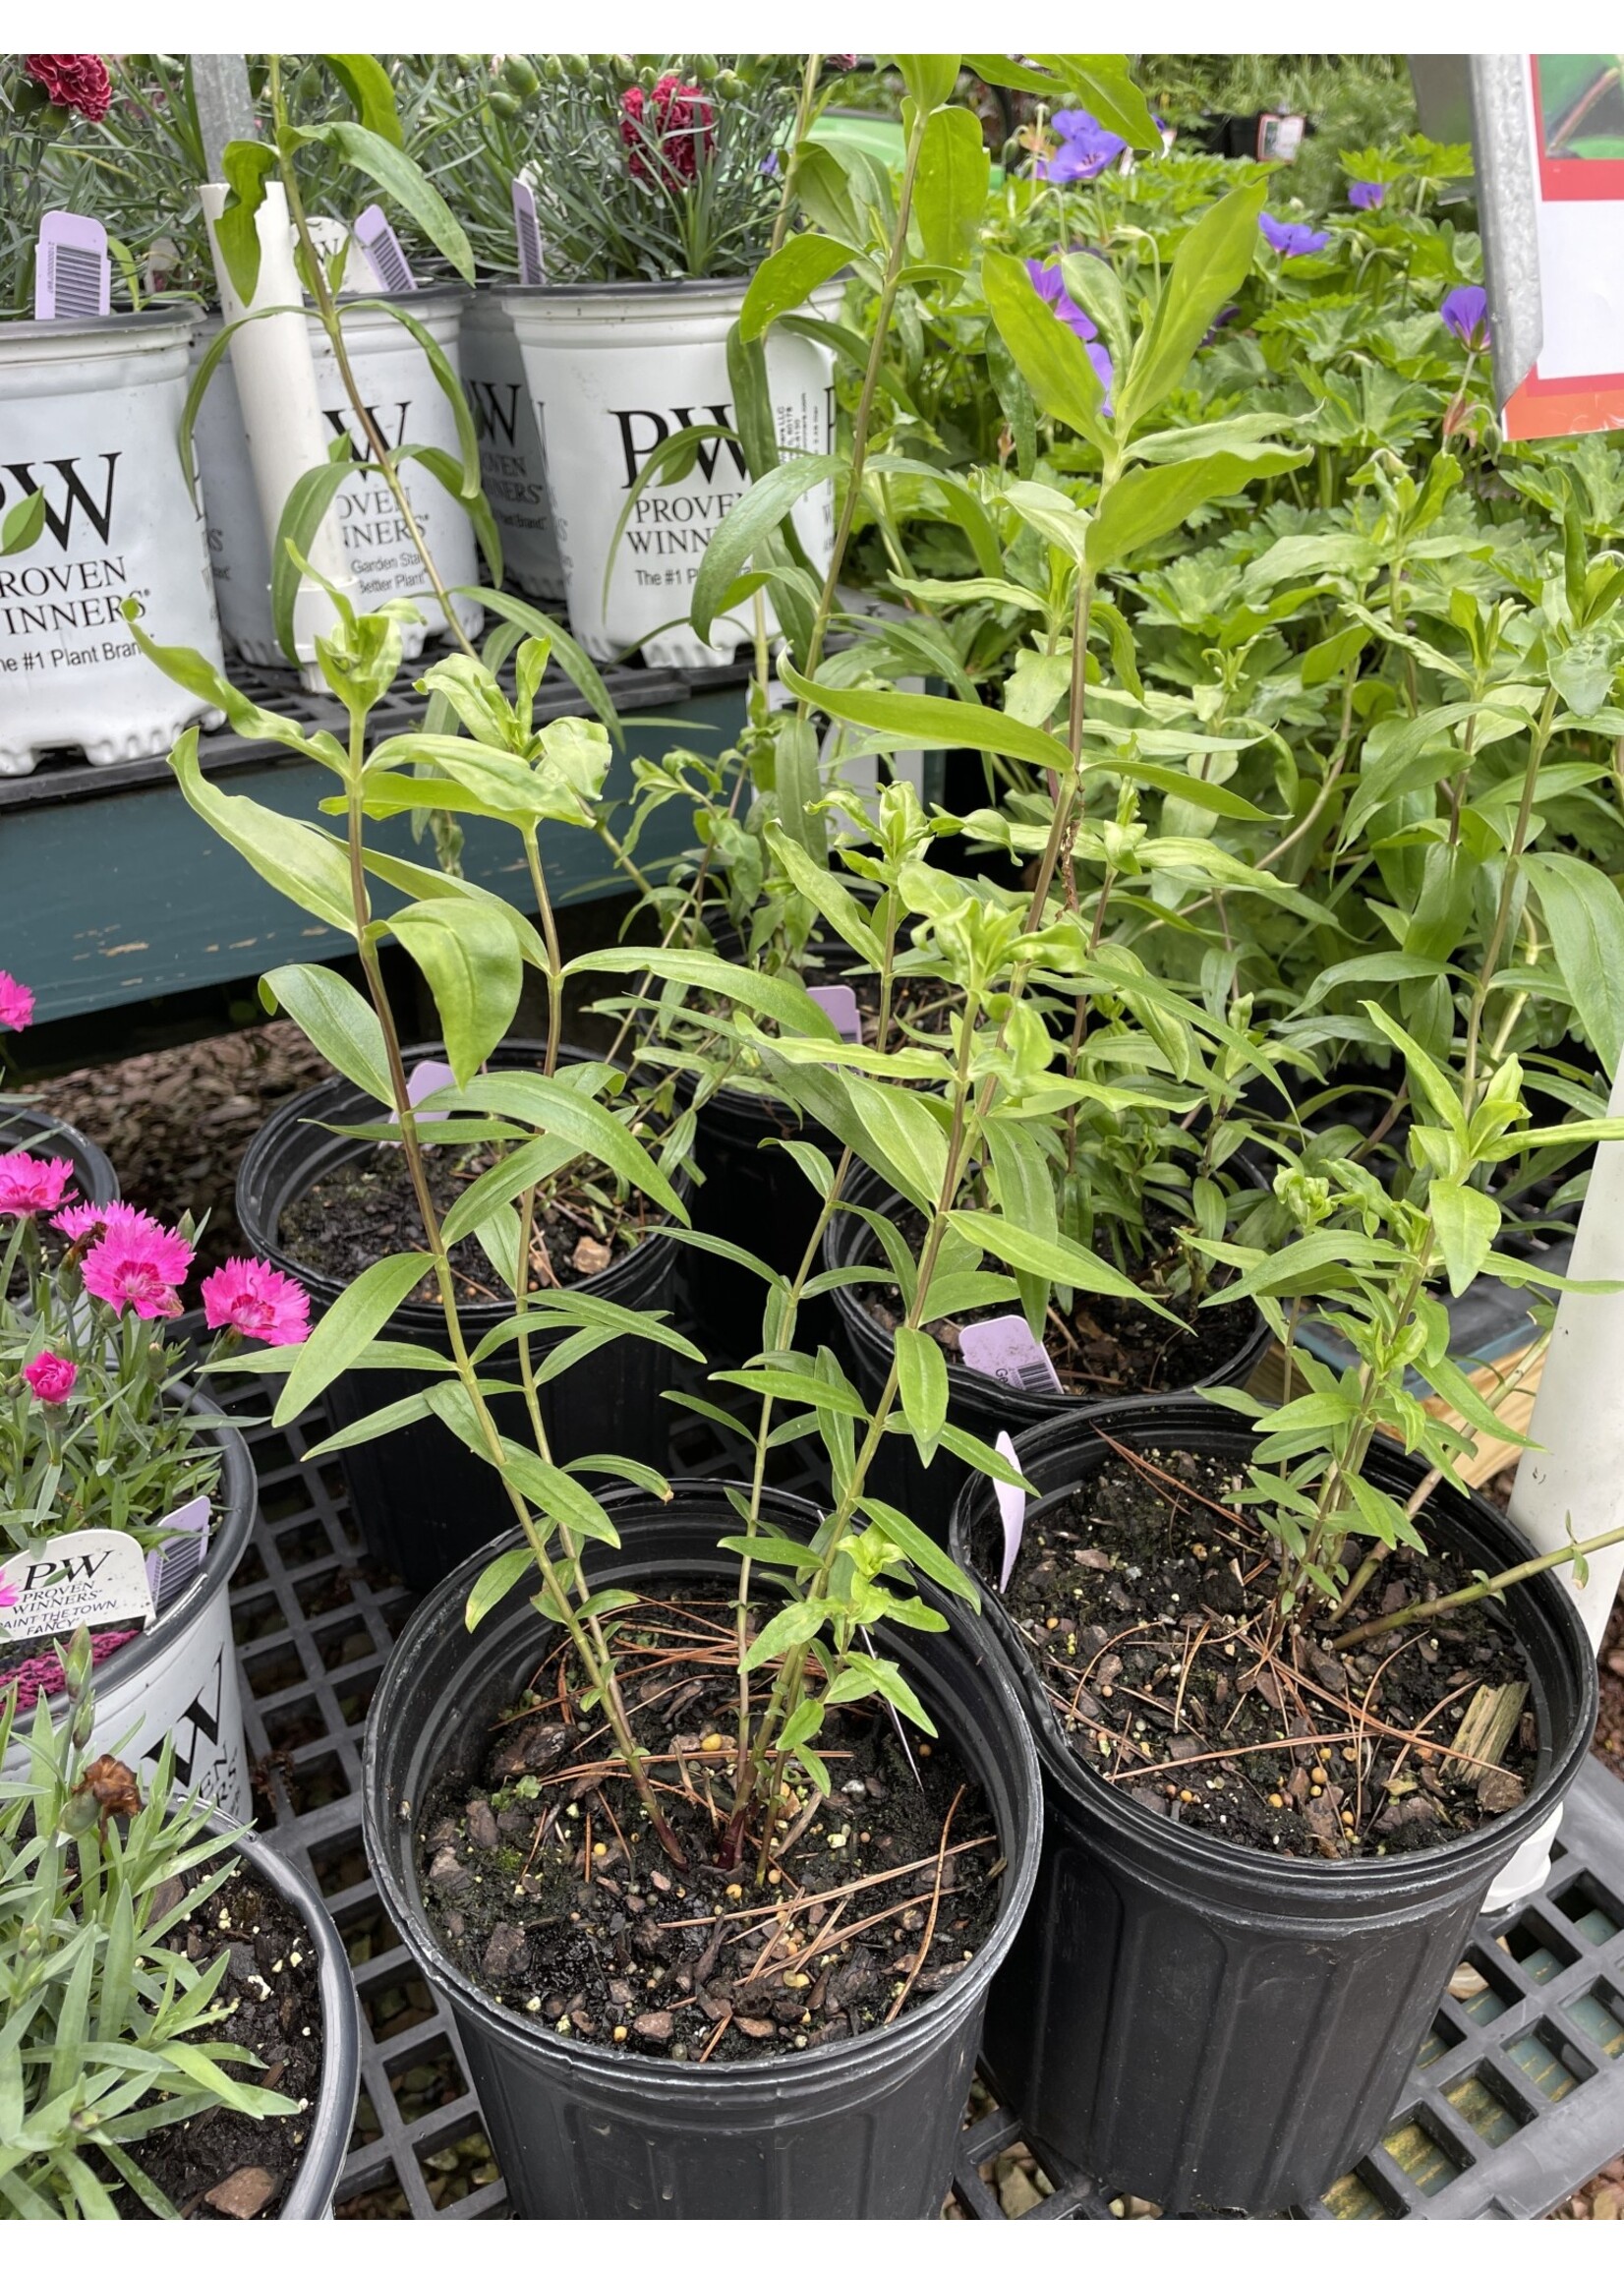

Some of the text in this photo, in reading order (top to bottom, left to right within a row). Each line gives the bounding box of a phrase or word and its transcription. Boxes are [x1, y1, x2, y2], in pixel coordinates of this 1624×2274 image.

[467, 379, 523, 446] W
[322, 401, 413, 482] W
[607, 403, 753, 490] PW
[0, 451, 123, 553] W
[635, 493, 743, 524] PROVE
[626, 527, 717, 555] WINN
[0, 555, 126, 599] ROVEN
[635, 569, 662, 586] The
[665, 568, 682, 586] #1
[23, 651, 44, 671] #1
[51, 646, 99, 668] Plant
[101, 640, 143, 661] Bran
[19, 1549, 115, 1593] PW
[22, 1580, 95, 1603] PROVEN
[0, 1600, 118, 1630] AINT THE TOWN
[141, 1643, 225, 1788] W
